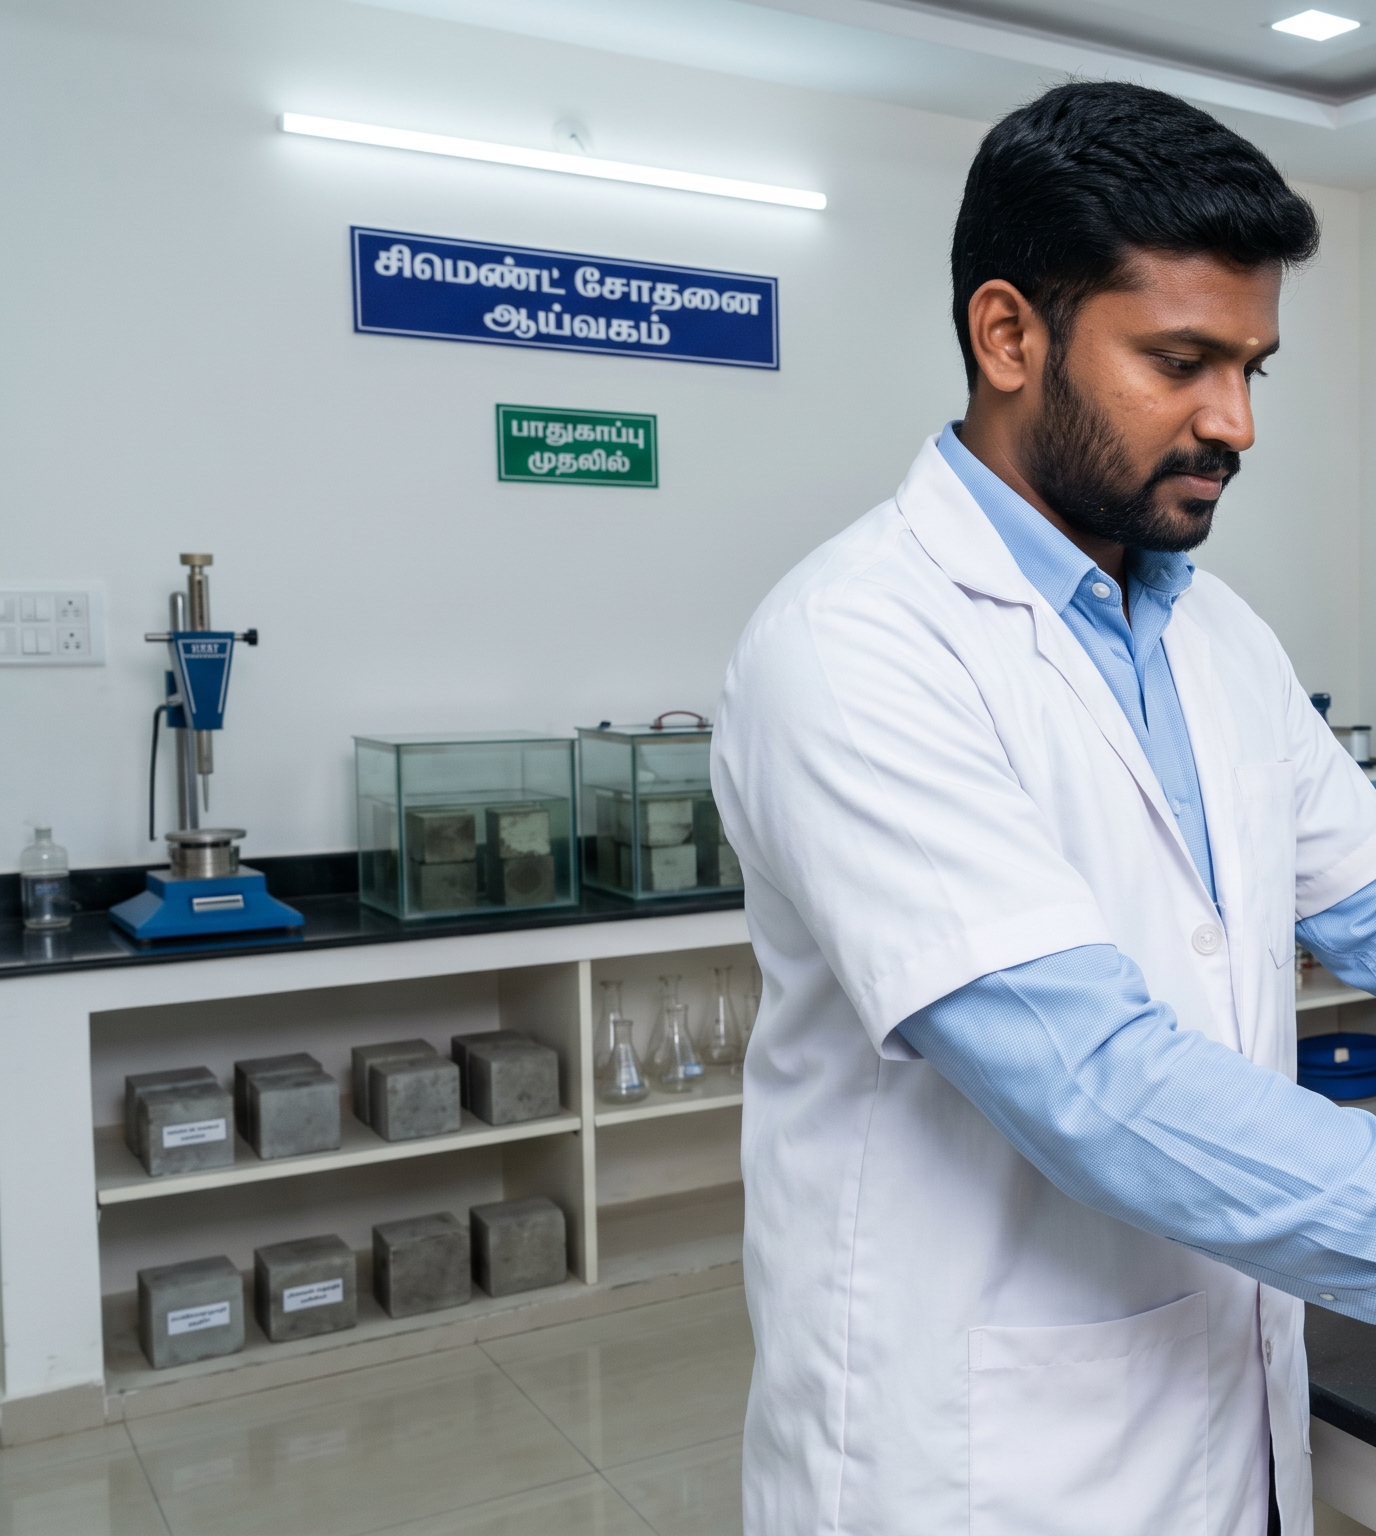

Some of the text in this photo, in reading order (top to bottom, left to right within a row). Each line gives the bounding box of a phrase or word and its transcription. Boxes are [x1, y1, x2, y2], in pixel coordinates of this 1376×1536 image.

[374, 244, 761, 316] சிமெண்ட் சோதனை
[483, 303, 671, 345] ஆய்வகம்
[512, 419, 645, 449] பாதுகாப்பு
[528, 449, 630, 476] முதலில்
